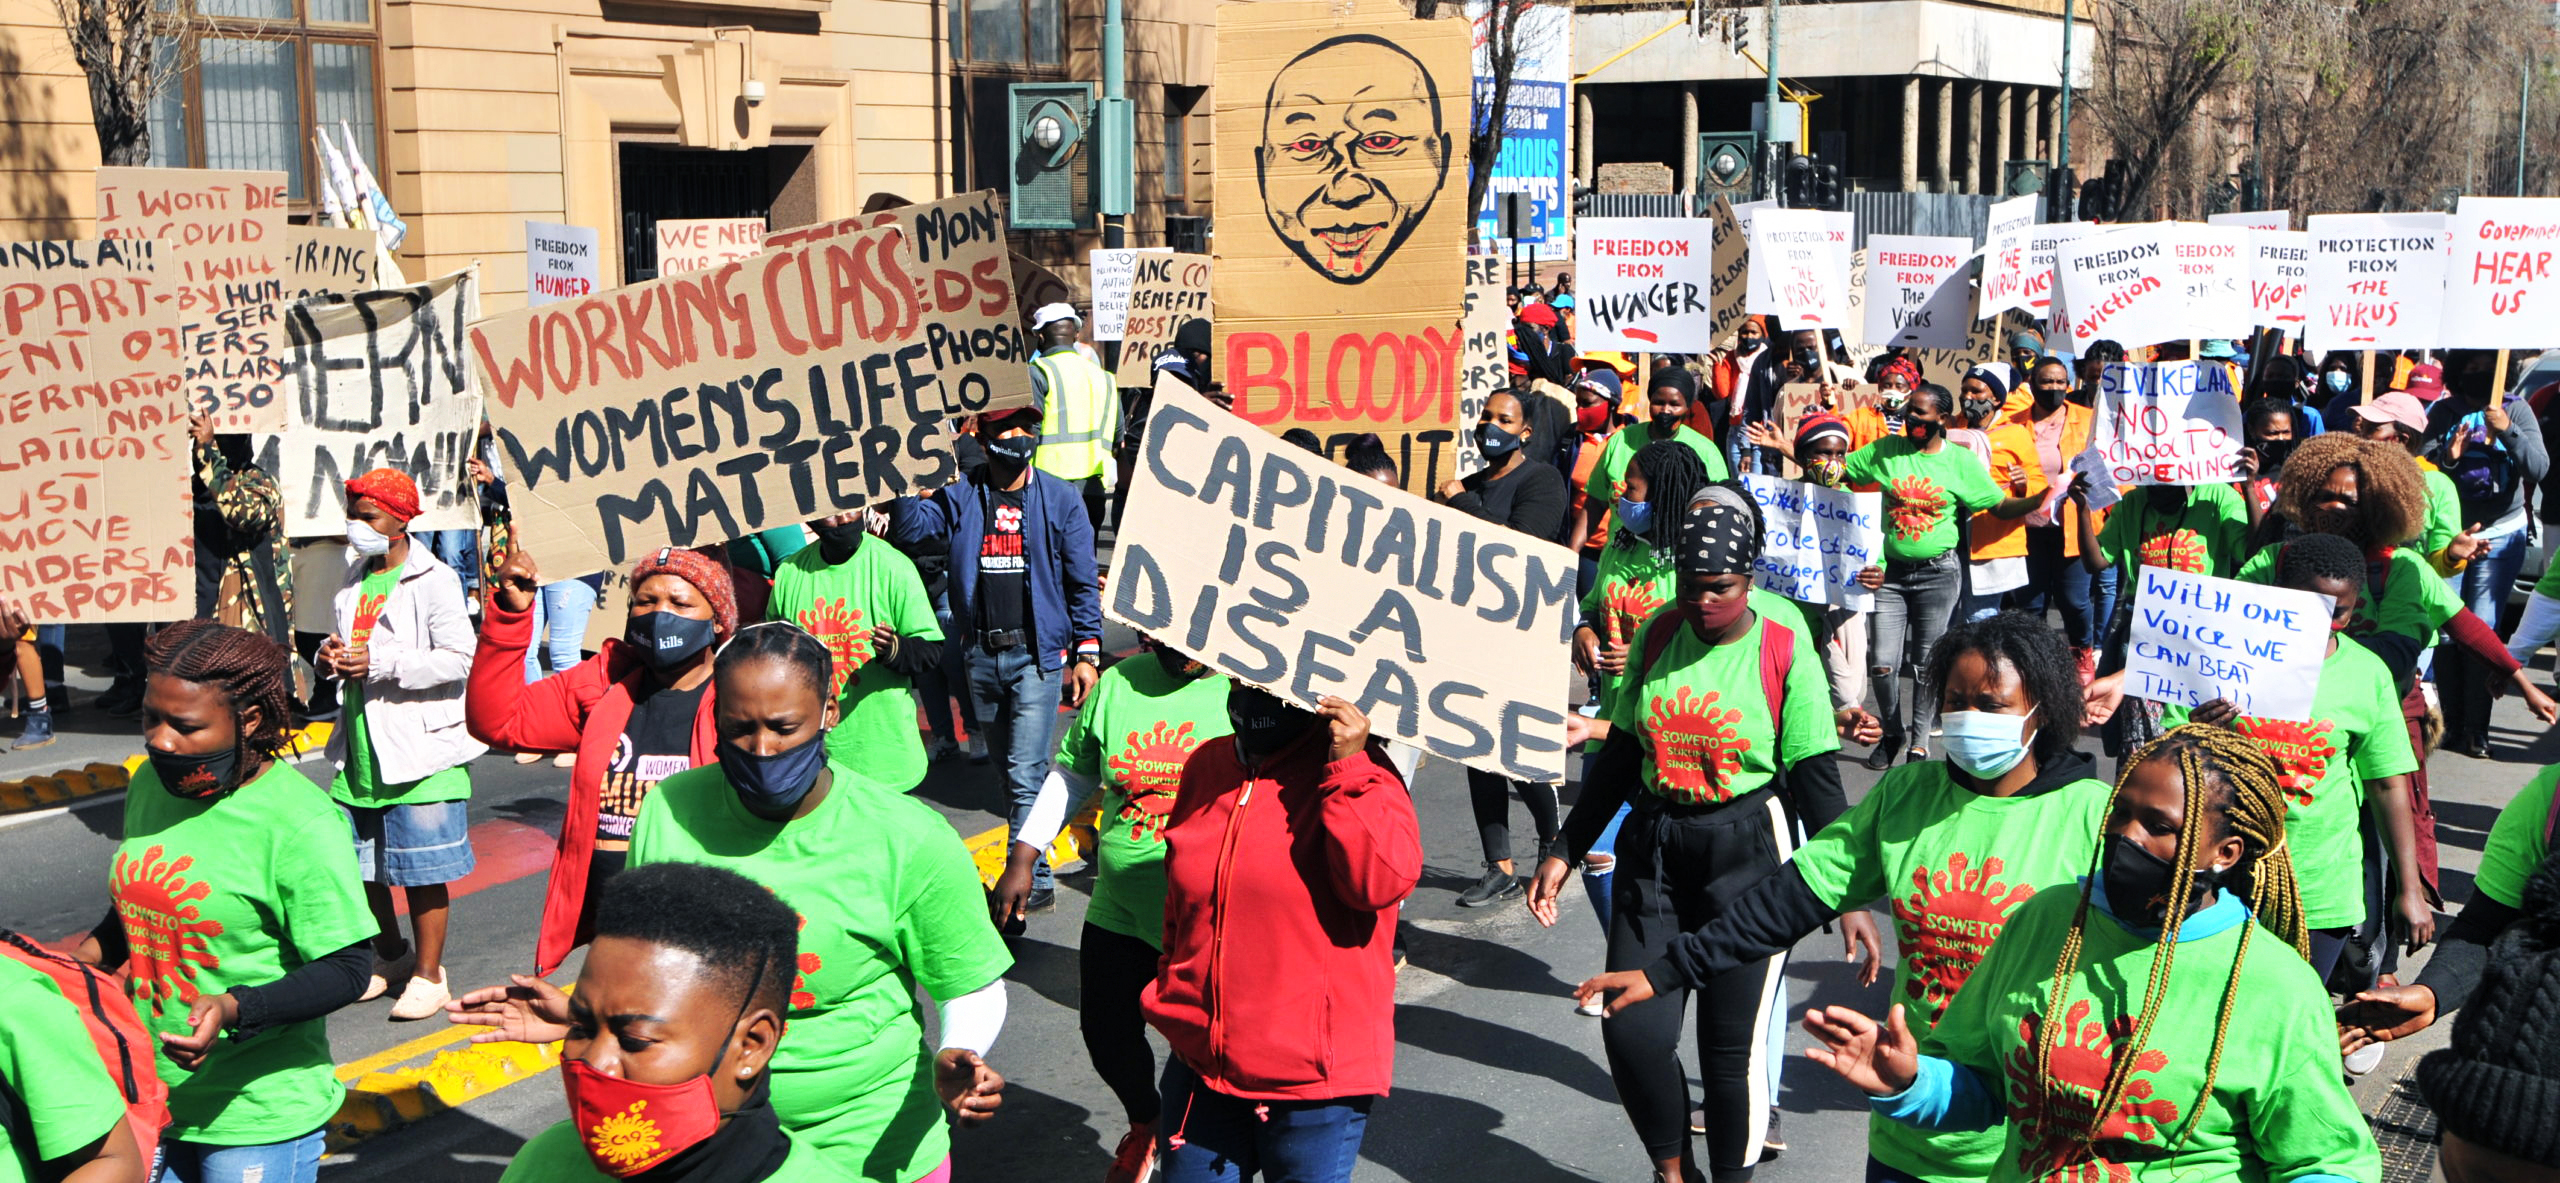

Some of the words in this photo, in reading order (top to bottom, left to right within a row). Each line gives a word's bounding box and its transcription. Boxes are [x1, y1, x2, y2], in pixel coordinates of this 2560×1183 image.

[99, 186, 121, 222] I
[243, 182, 287, 212] DIE
[660, 225, 709, 250] WE
[1766, 231, 1825, 243] PROTECTION
[1992, 214, 2033, 237] PROTECTION
[535, 237, 588, 257] FREEDOM
[1593, 239, 1689, 257] FREEDOM
[1788, 249, 1814, 260] FROM
[1998, 247, 2021, 269] THE
[2074, 242, 2160, 272] FREEDOM
[2318, 237, 2435, 254] PROTECTION
[184, 261, 194, 282] I
[203, 254, 275, 281] WILL
[286, 239, 366, 284] IRING
[548, 258, 574, 272] FROM
[1135, 258, 1173, 286] ANC
[1182, 262, 1211, 288] CO
[1617, 264, 1664, 278] FROM
[1879, 251, 1957, 269] FREEDOM
[2348, 259, 2398, 273] FROM
[2473, 251, 2552, 285] HEAR
[1792, 266, 1815, 283] THE
[1897, 271, 1935, 285] FROM
[1986, 270, 2021, 300] VIRUS
[2098, 266, 2141, 286] FROM
[178, 284, 221, 314] BY
[1133, 290, 1208, 312] BENEFIT
[1783, 283, 1826, 309] VIRUS
[1901, 288, 1925, 308] The
[2251, 276, 2307, 311] Viole
[2347, 280, 2389, 297] THE
[1588, 281, 1706, 333] HUNGER
[2075, 275, 2162, 340] eviction
[2330, 301, 2400, 328] VIRUS
[2491, 290, 2526, 316] US
[470, 262, 757, 408] WORKING
[762, 226, 920, 357] CLASS
[1098, 322, 1124, 335] YOUR
[1125, 316, 1167, 338] BOSS
[926, 322, 1026, 371] PHOSA
[1226, 326, 1464, 426] BLOODY
[186, 383, 274, 416] 350
[938, 371, 992, 412] LO
[108, 402, 184, 435] NAL
[497, 366, 801, 491] WOMEN'S
[808, 342, 944, 437] LIFE
[2113, 402, 2168, 439] NO
[2183, 426, 2227, 456] TO
[597, 423, 957, 565] MATTERS
[1147, 404, 1577, 644] CAPITALISM
[1762, 526, 1841, 554] rotect
[1219, 523, 1310, 613] IS
[1349, 588, 1427, 664] A
[2243, 603, 2302, 632] ONE
[659, 635, 684, 650] kills
[2244, 638, 2288, 663] WE
[1113, 543, 1566, 785] DISEASE
[2136, 641, 2190, 667] CAN
[2200, 654, 2254, 684] BEAT
[1251, 716, 1277, 730] kills
[1661, 730, 1720, 749] SOWETO
[1135, 759, 1184, 775] SOWET
[1666, 759, 1709, 771] SINQO
[119, 899, 179, 931] SOWETO
[1926, 912, 2003, 940] SOWETO
